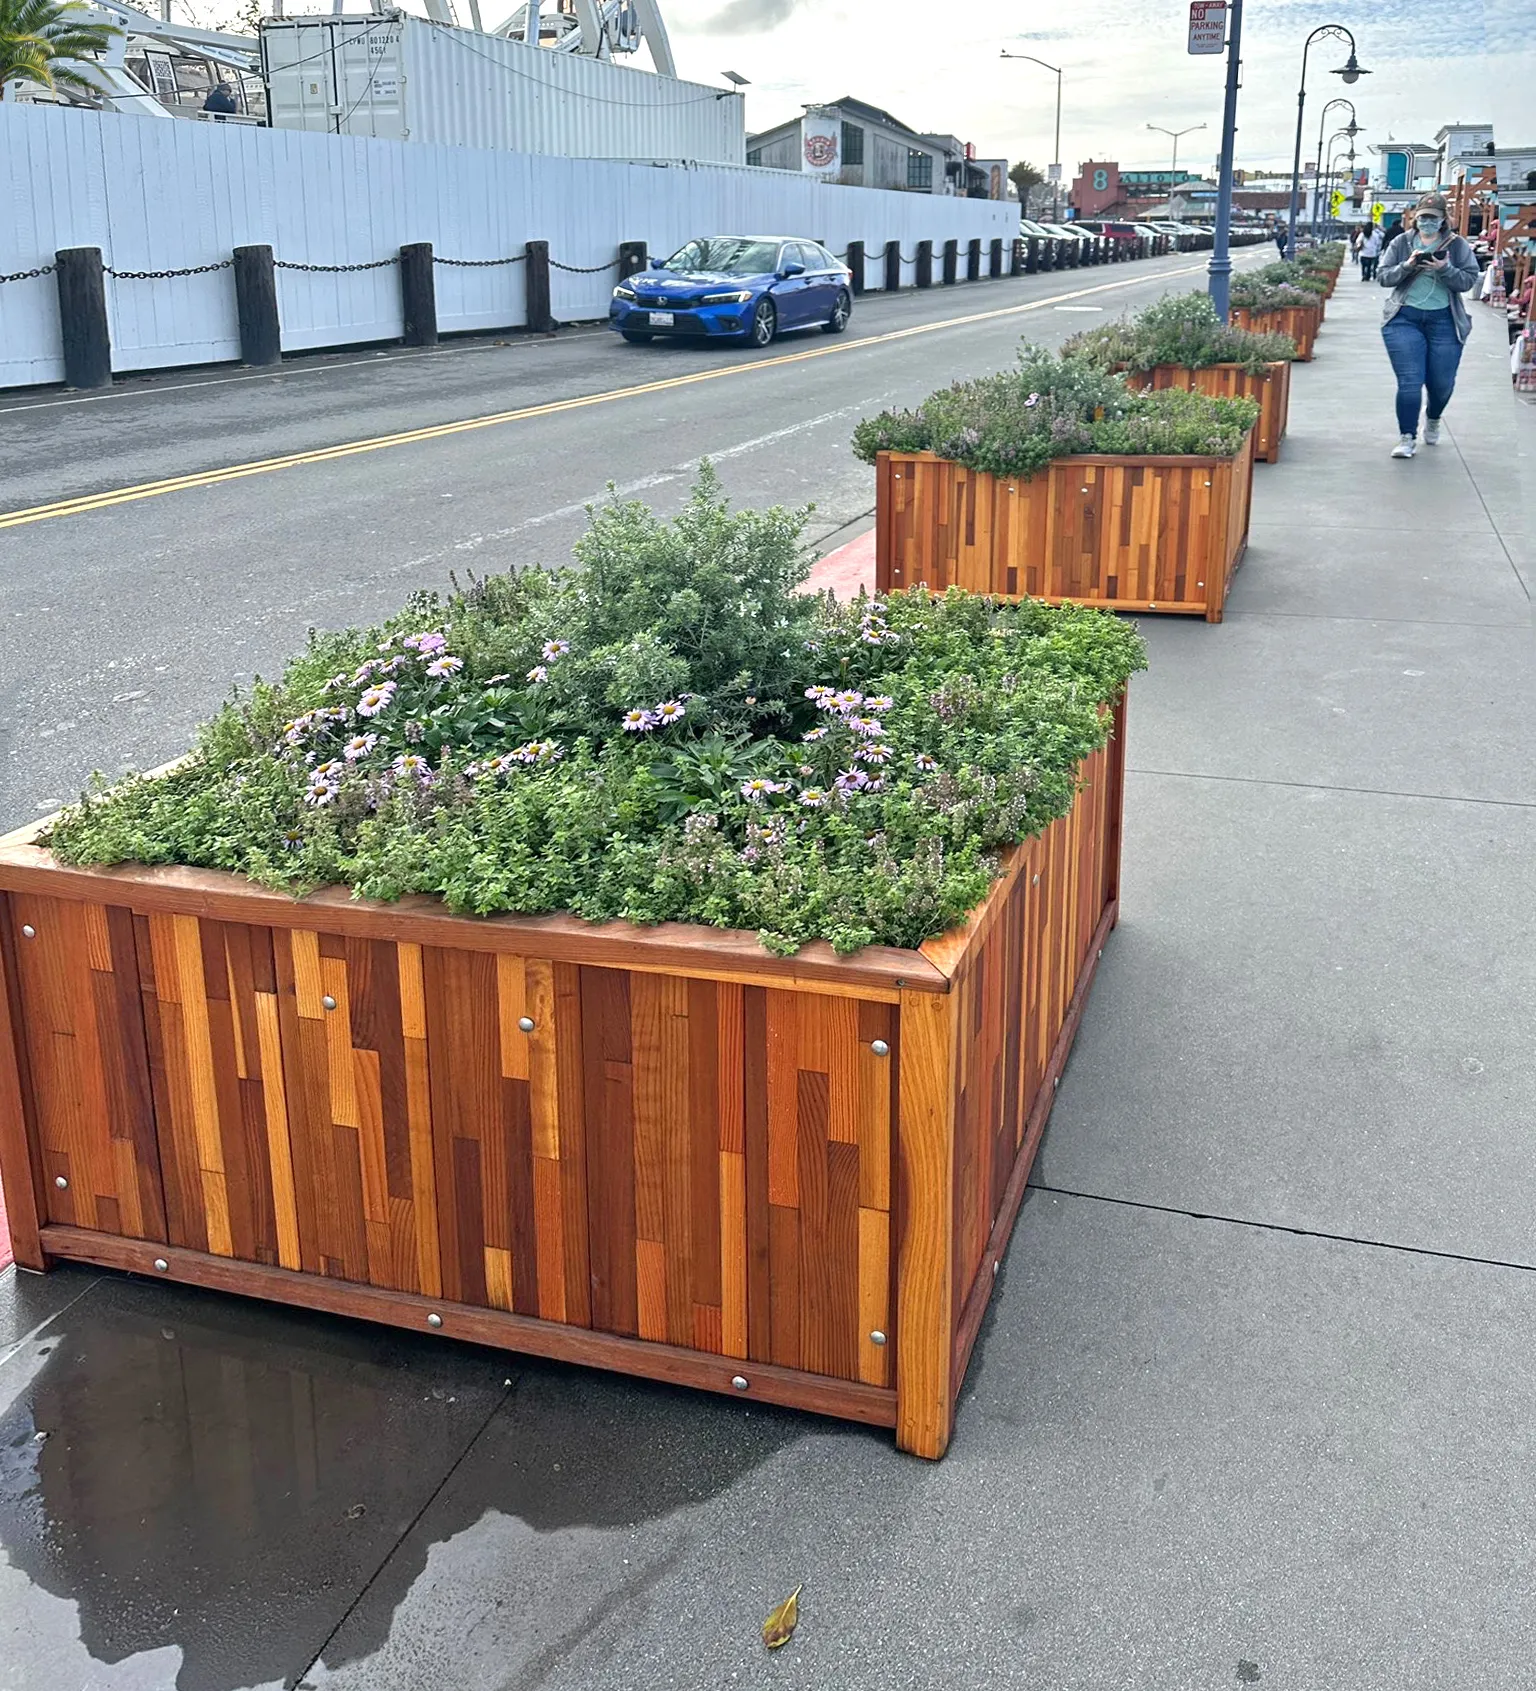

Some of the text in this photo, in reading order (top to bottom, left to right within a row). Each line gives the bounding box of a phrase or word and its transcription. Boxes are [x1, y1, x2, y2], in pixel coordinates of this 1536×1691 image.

[1191, 9, 1204, 19] NO
[1191, 21, 1223, 30] PARKING
[1093, 169, 1108, 191] 8
